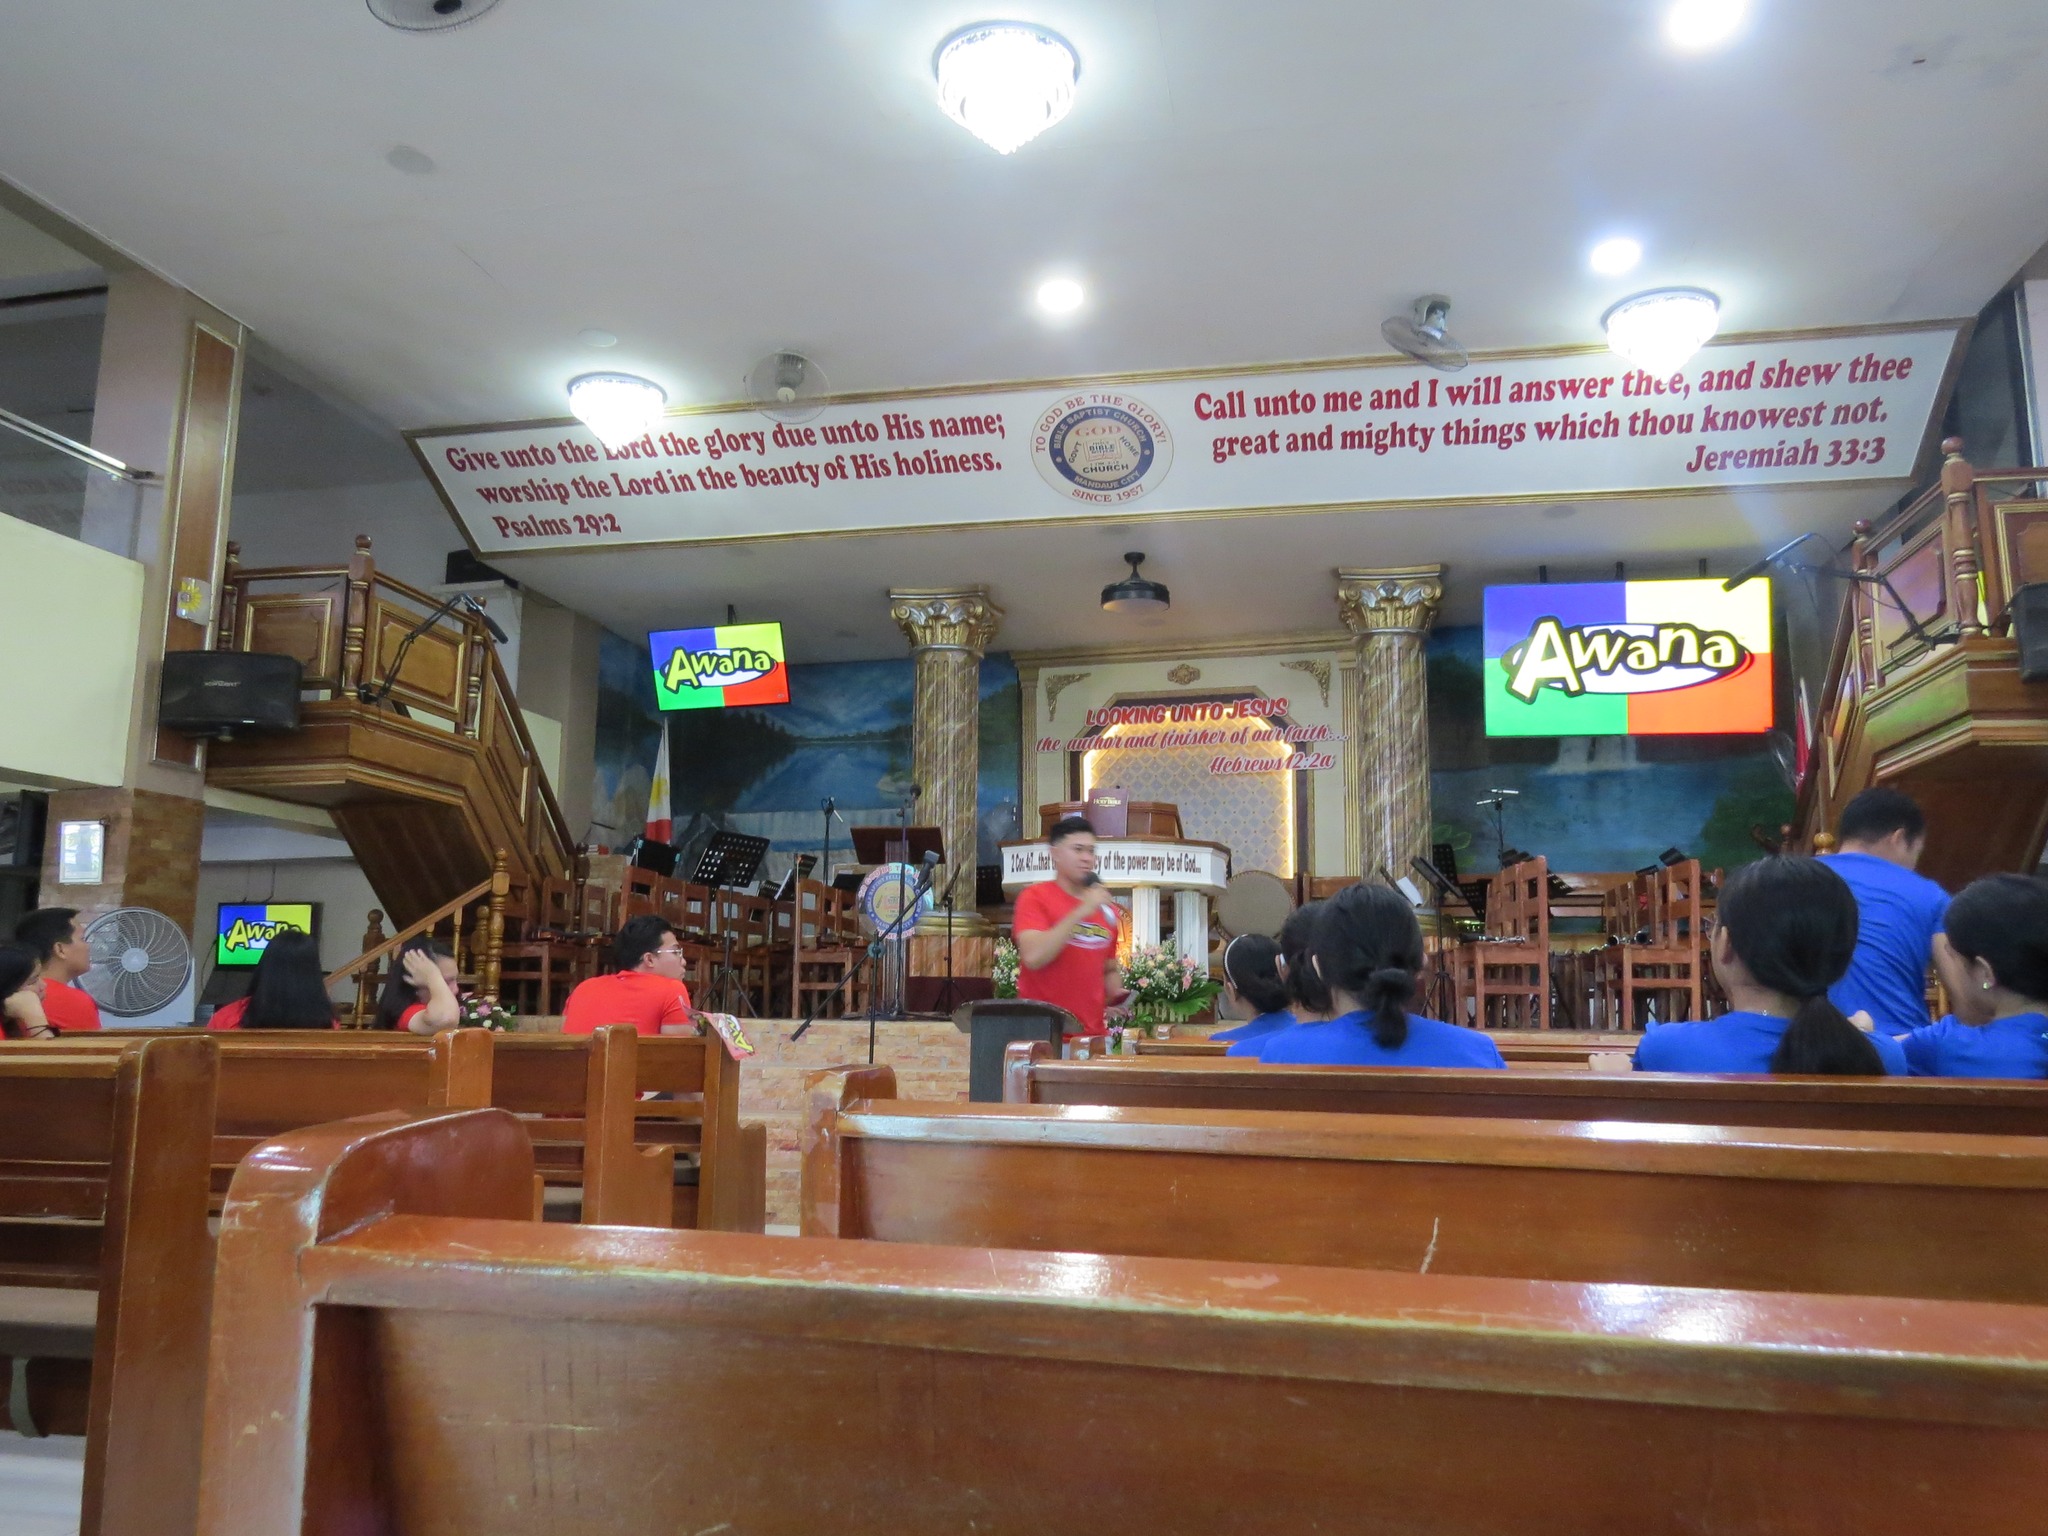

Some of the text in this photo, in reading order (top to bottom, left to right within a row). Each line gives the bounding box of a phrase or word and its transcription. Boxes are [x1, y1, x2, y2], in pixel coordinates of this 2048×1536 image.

[1194, 353, 1914, 420] Call unto me and I will answer thee, and shew thee
[1036, 394, 1167, 452] TO GOD BE THE GLORY!
[1054, 408, 1146, 448] BIBLE BAPTIST CHURCH
[1212, 396, 1888, 463] great and mighty things which thou knowest not.
[446, 413, 1005, 472] Give unto the Lord the glory due unto His name;
[1089, 444, 1114, 452] BIBLE
[1120, 436, 1139, 457] HOME
[1686, 436, 1886, 473] Jeremiah 33:3
[476, 449, 1002, 505] worship the Lord in the beauty of His holiness.
[1074, 471, 1140, 488] MANDAUE CITY
[1083, 464, 1128, 474] CHURCH
[1072, 484, 1144, 502] SINCE 1957
[492, 513, 622, 538] Psalms 29:2
[665, 647, 772, 692] Awana
[1509, 618, 1738, 702] Awana
[1085, 698, 1288, 726] LOOKING UNTO JESUS
[1036, 736, 1061, 752] the
[1064, 733, 1121, 751] author
[1124, 731, 1156, 749] and
[1159, 728, 1226, 750] finisher
[1230, 728, 1248, 748] of
[1250, 728, 1284, 742] our
[1208, 752, 1335, 774] Hebrews 12:2a
[1011, 853, 1015, 873] 2
[1104, 850, 1112, 870] of
[1114, 850, 1126, 870] the
[1128, 854, 1150, 875] power
[1151, 856, 1165, 876] may
[1167, 852, 1174, 871] be
[1176, 853, 1183, 872] of
